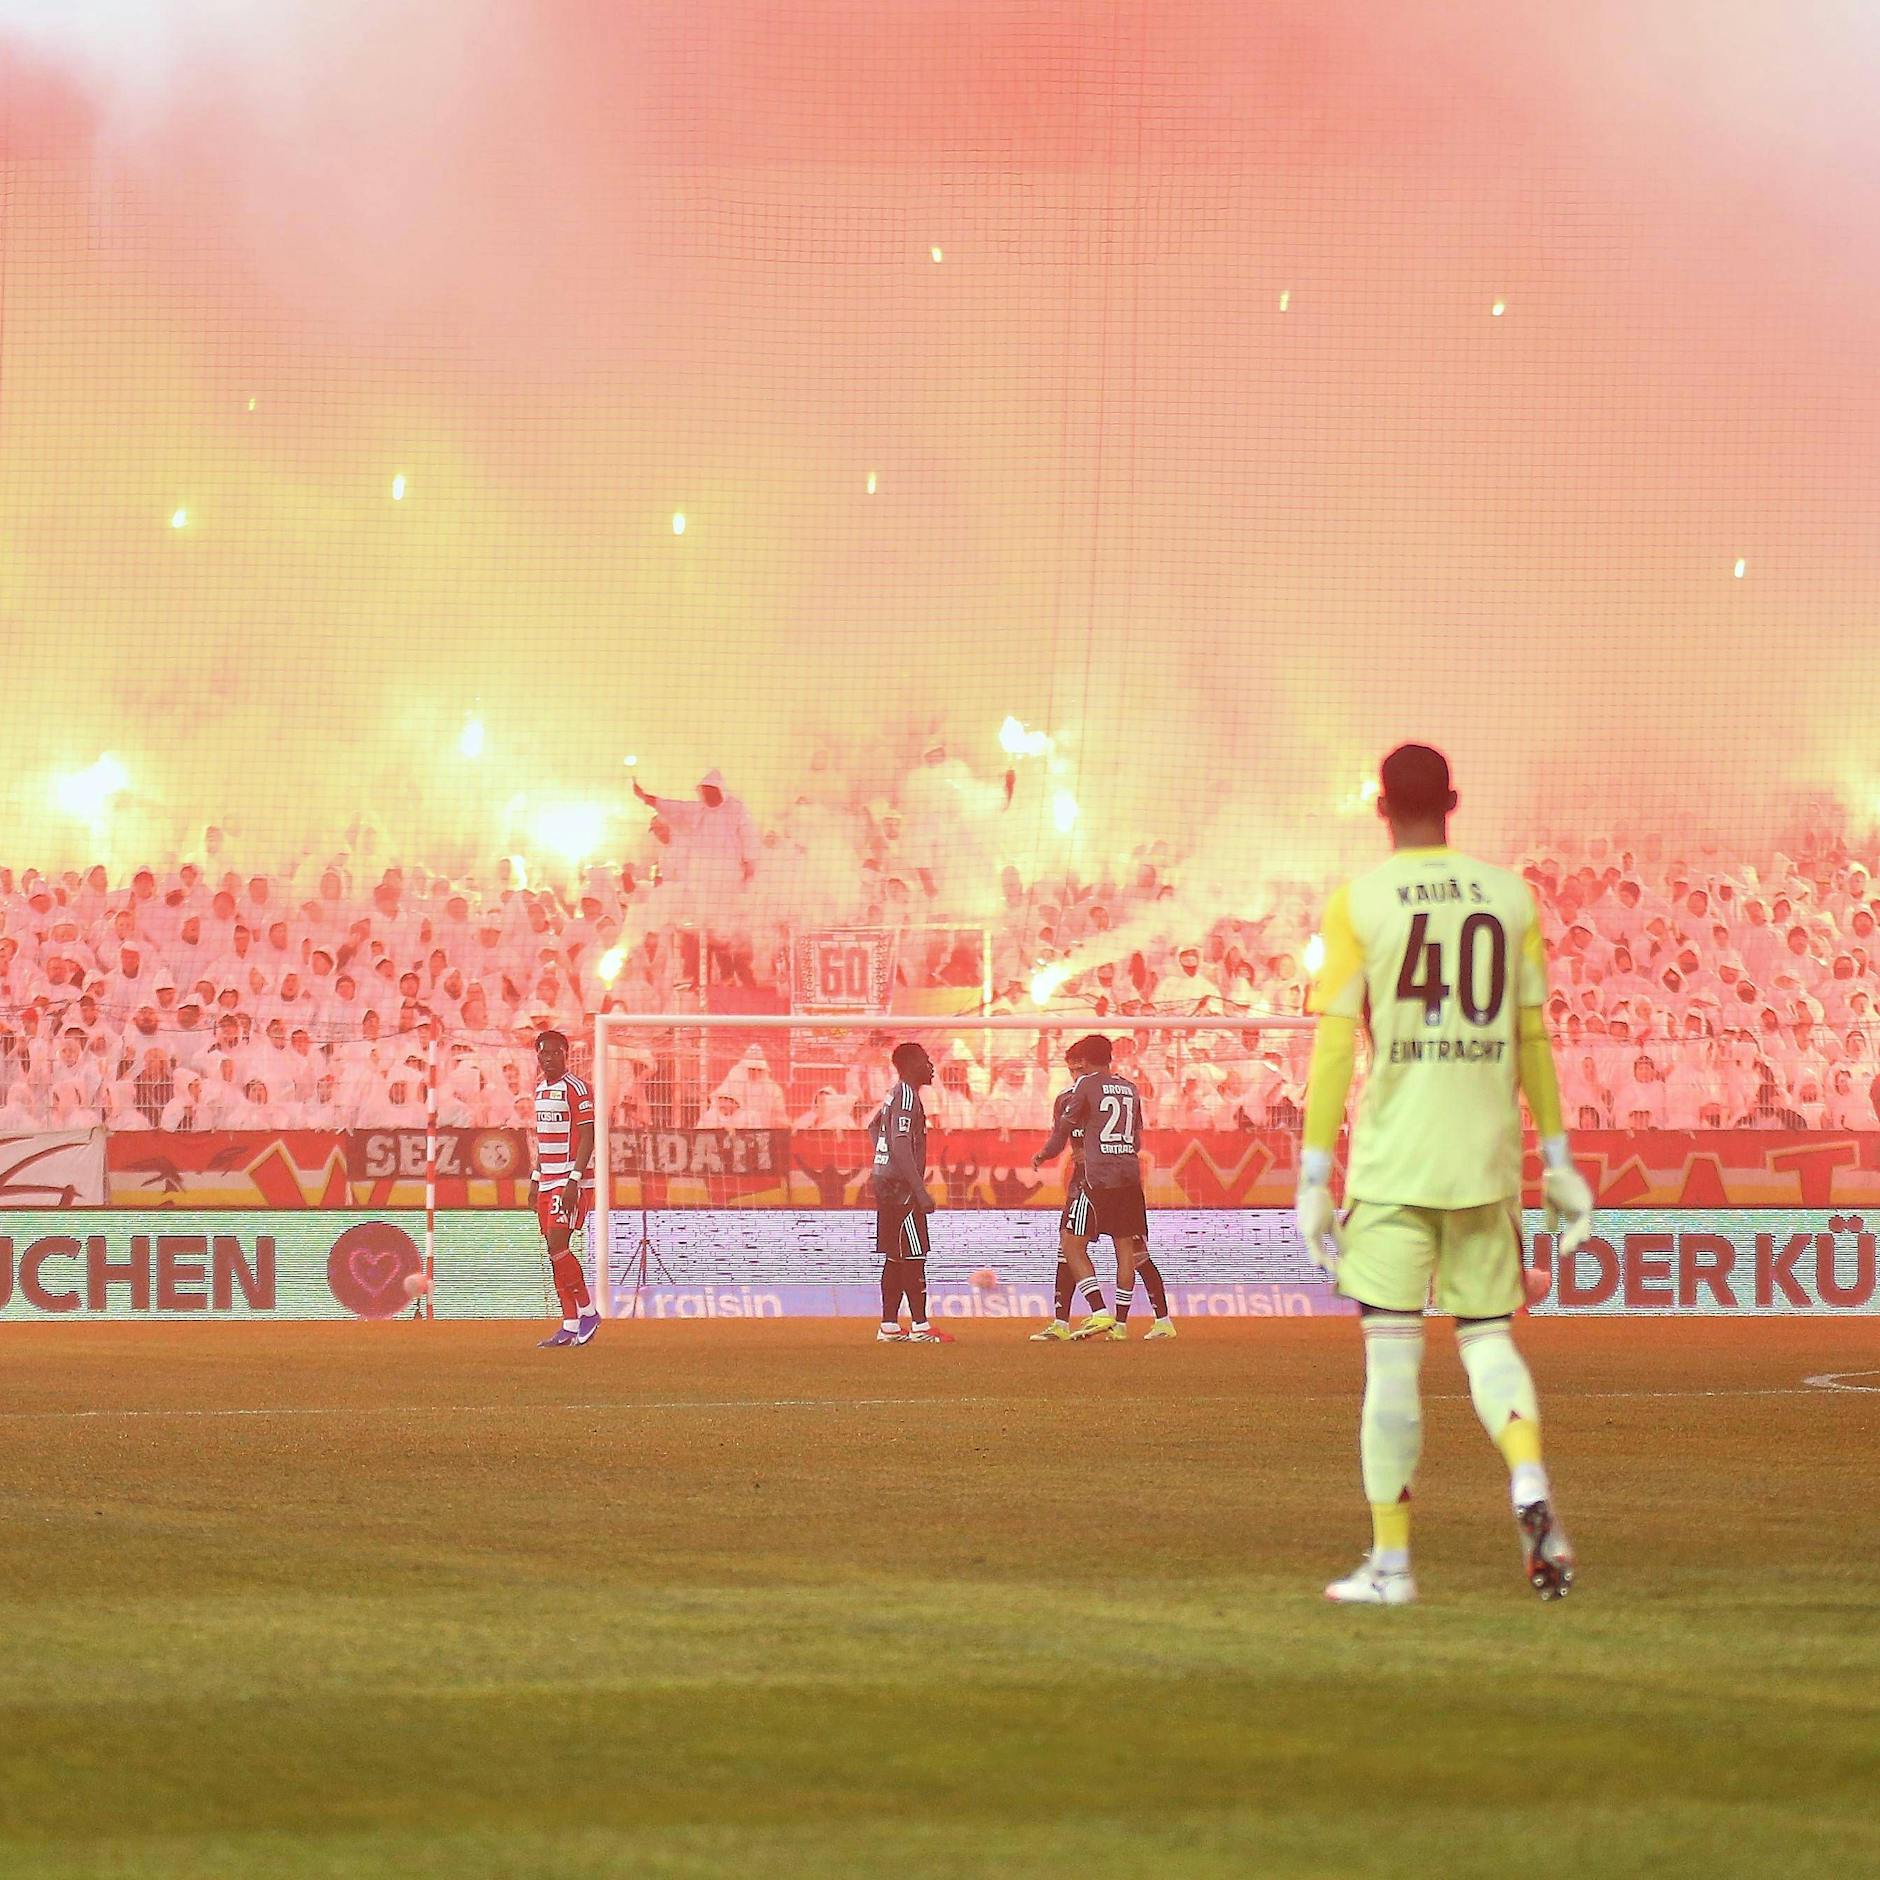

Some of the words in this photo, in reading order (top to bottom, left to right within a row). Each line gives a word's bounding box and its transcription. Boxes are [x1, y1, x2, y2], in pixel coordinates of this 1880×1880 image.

[820, 946, 869, 998] 60
[1397, 912, 1506, 1026] 40
[1390, 1039, 1506, 1065] EINTRACHT
[1100, 1096, 1135, 1144] 21
[365, 1134, 474, 1178] SEZ.
[0, 1234, 277, 1313] CHEN
[1755, 1214, 1877, 1309] KÜ
[654, 1286, 783, 1318] raisin
[926, 1286, 1048, 1318] raisin
[1187, 1284, 1313, 1317] raisin
